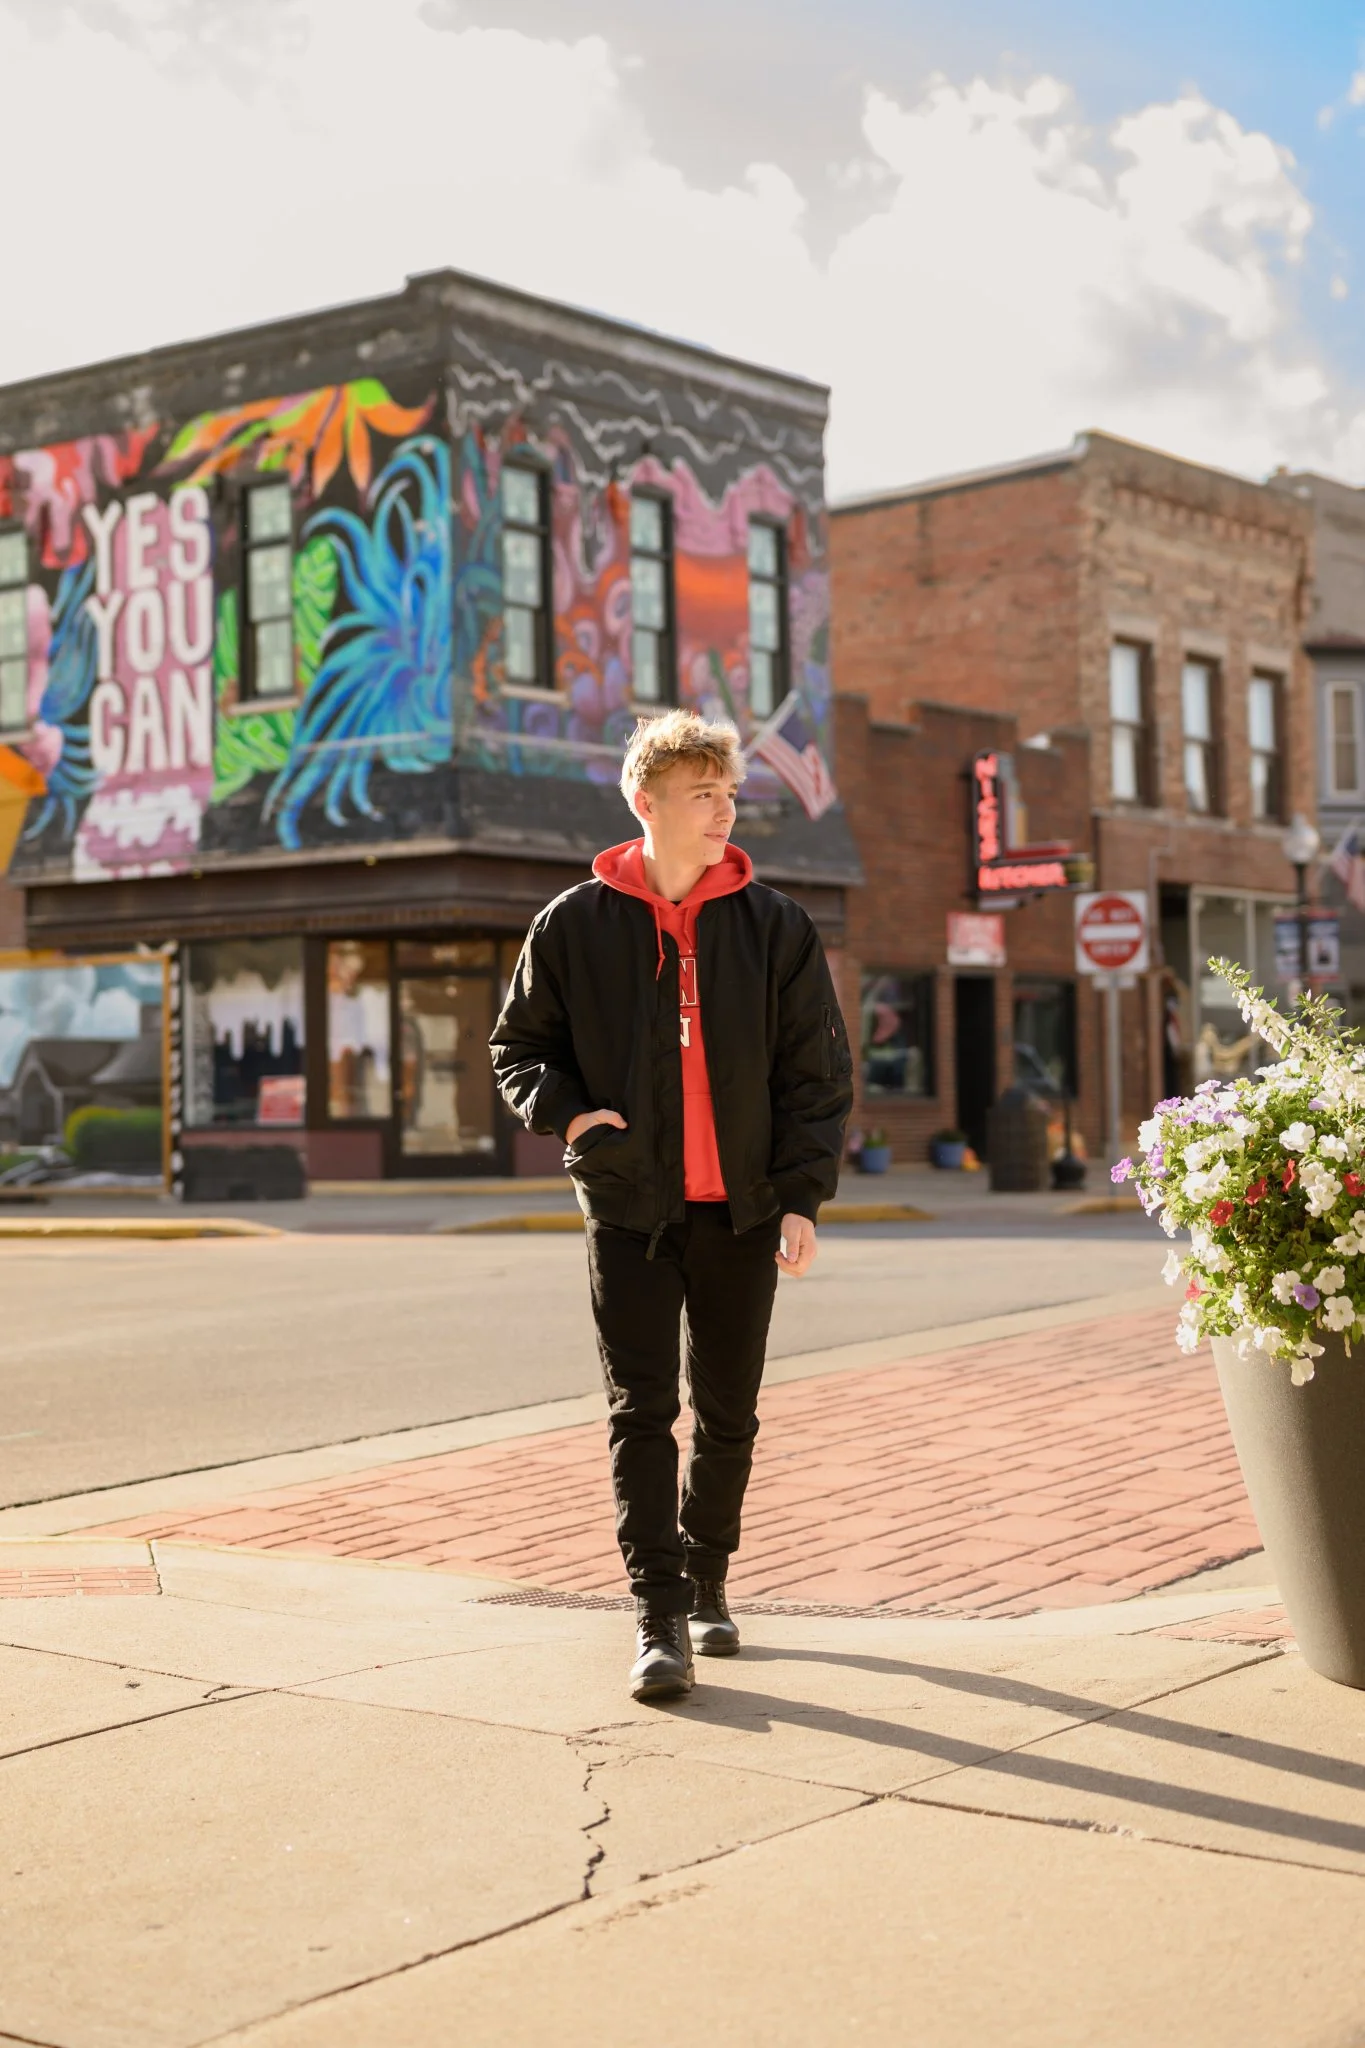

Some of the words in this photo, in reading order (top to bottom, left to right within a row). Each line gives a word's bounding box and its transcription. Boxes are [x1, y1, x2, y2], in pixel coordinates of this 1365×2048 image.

[83, 486, 211, 594] YES
[86, 575, 213, 680] YOU
[91, 668, 212, 775] CAN
